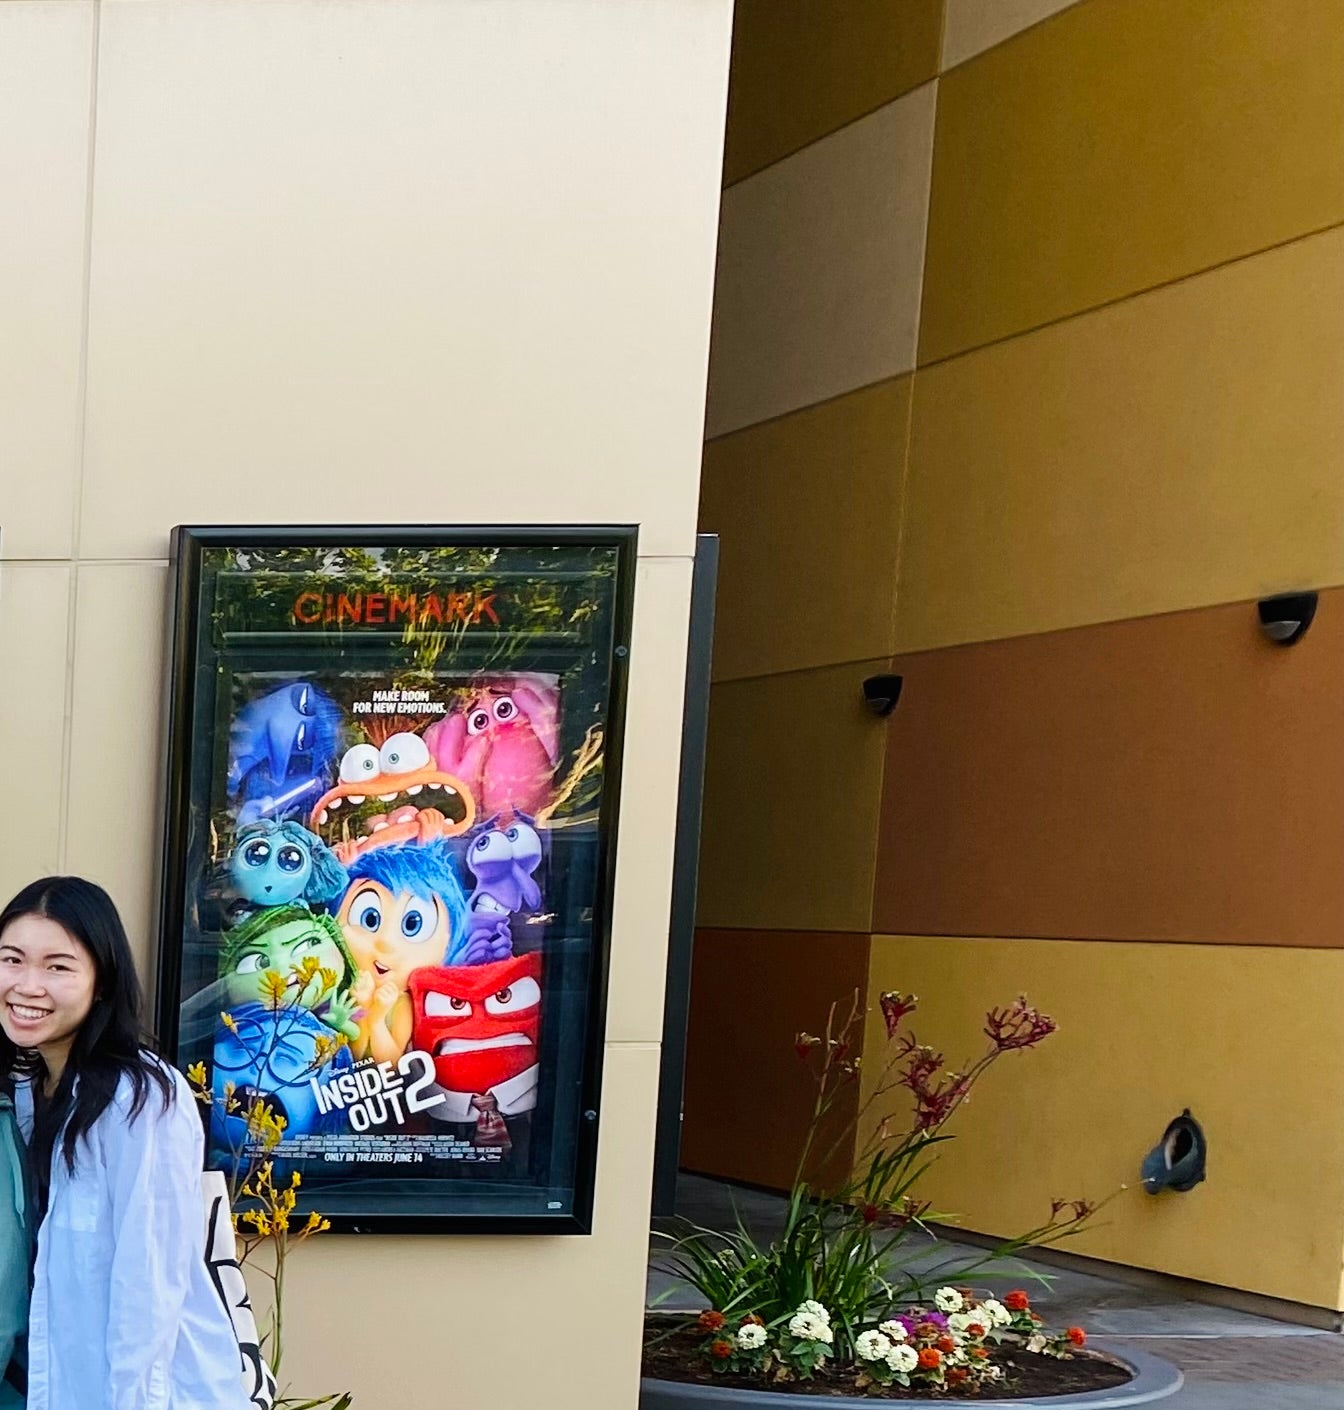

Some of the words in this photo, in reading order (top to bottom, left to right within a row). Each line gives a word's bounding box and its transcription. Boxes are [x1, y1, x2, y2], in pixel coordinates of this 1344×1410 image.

[293, 592, 500, 624] CINEMARK
[372, 690, 400, 702] MAKE
[401, 690, 430, 702] ROOM
[353, 702, 372, 714] FOR
[373, 702, 397, 714] NEW
[397, 702, 447, 714] EMOTIONS.
[310, 1060, 404, 1116] INSIDE
[348, 1086, 406, 1132] OUT
[398, 1050, 446, 1114] 2
[324, 1152, 345, 1162] ONLY
[355, 1152, 394, 1163] THEATERS
[393, 1152, 413, 1164] JUNE
